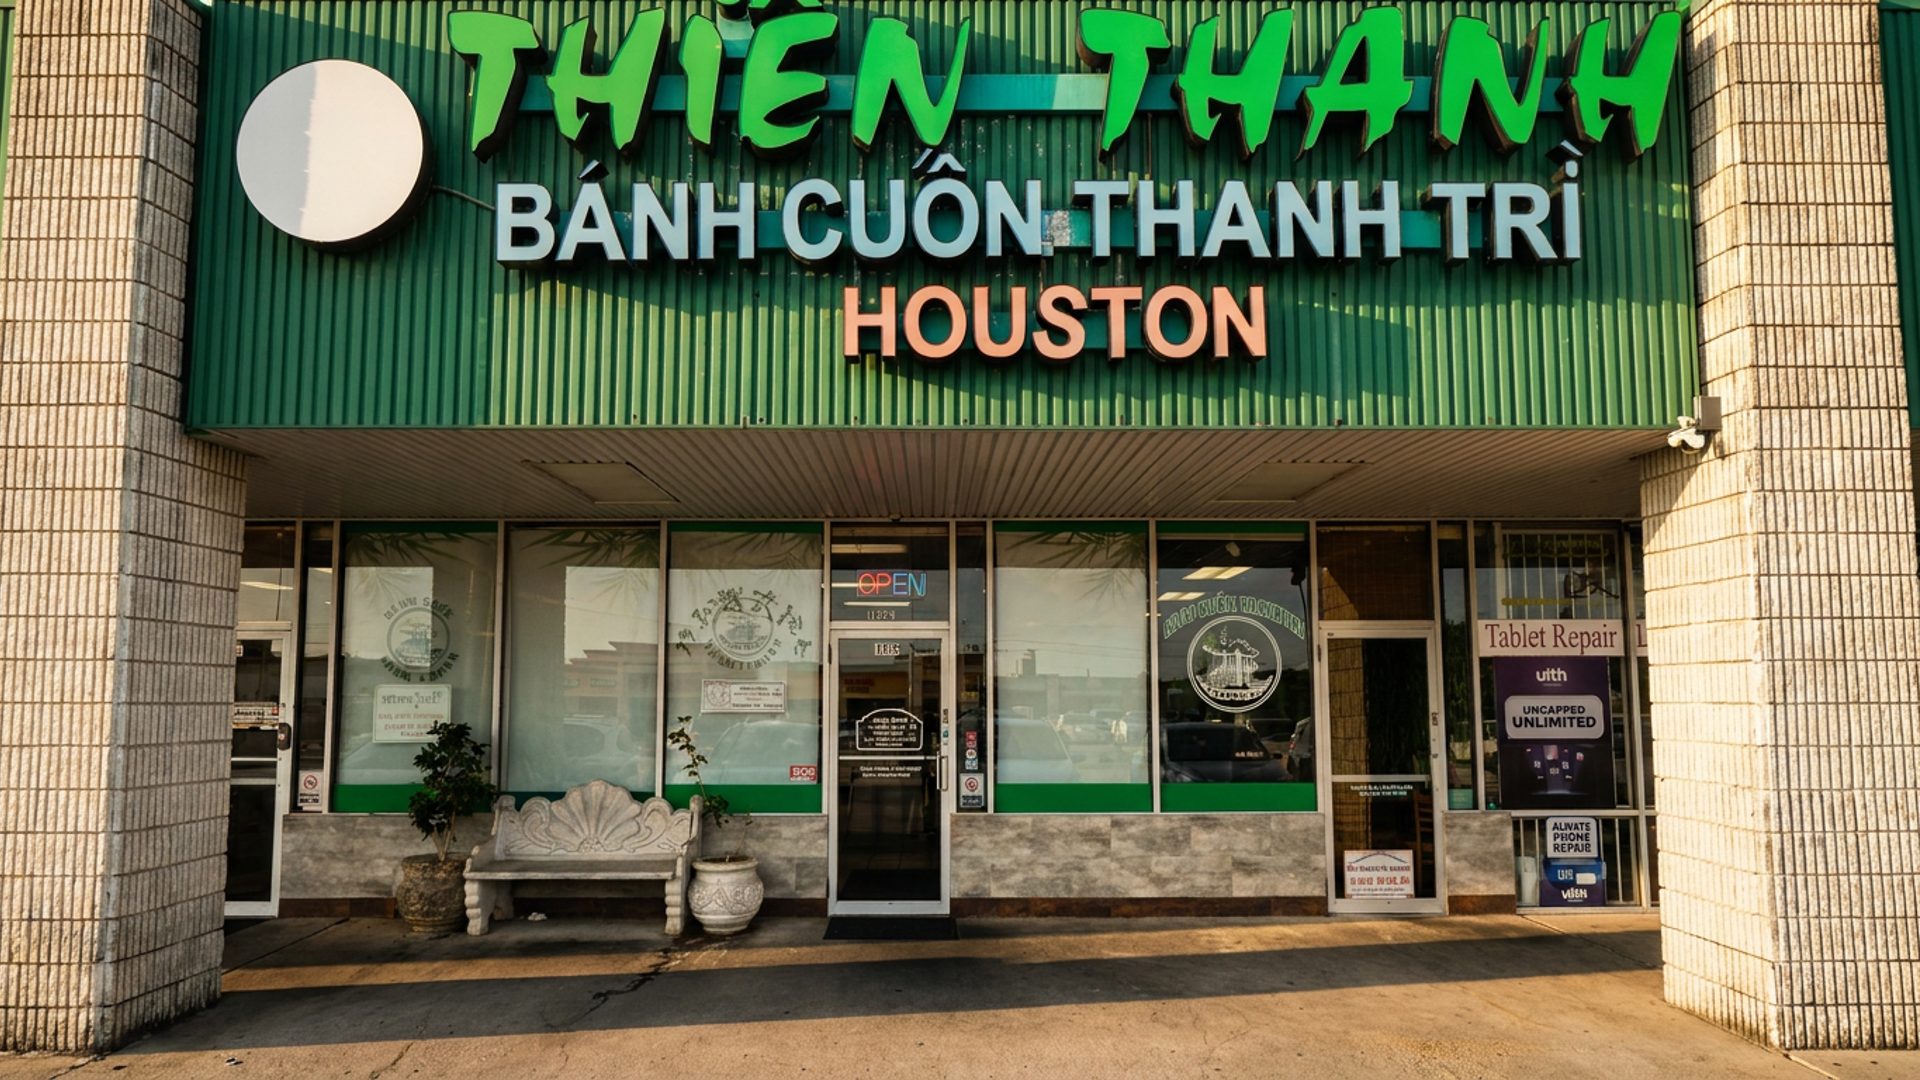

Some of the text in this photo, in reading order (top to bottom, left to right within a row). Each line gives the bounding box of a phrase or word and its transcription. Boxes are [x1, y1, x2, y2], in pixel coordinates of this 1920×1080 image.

[1079, 6, 1682, 154] THANH
[496, 160, 756, 261] BÁNH
[1073, 179, 1401, 259] THANH
[1431, 139, 1583, 259] TRÌ
[843, 284, 1267, 360] HOUSTON
[858, 572, 927, 597] OPEN
[1485, 623, 1617, 655] Tablet Repair
[1512, 716, 1597, 728] UNLIMITED
[1523, 705, 1586, 714] UNCAPPED
[1553, 832, 1590, 841] PHONE
